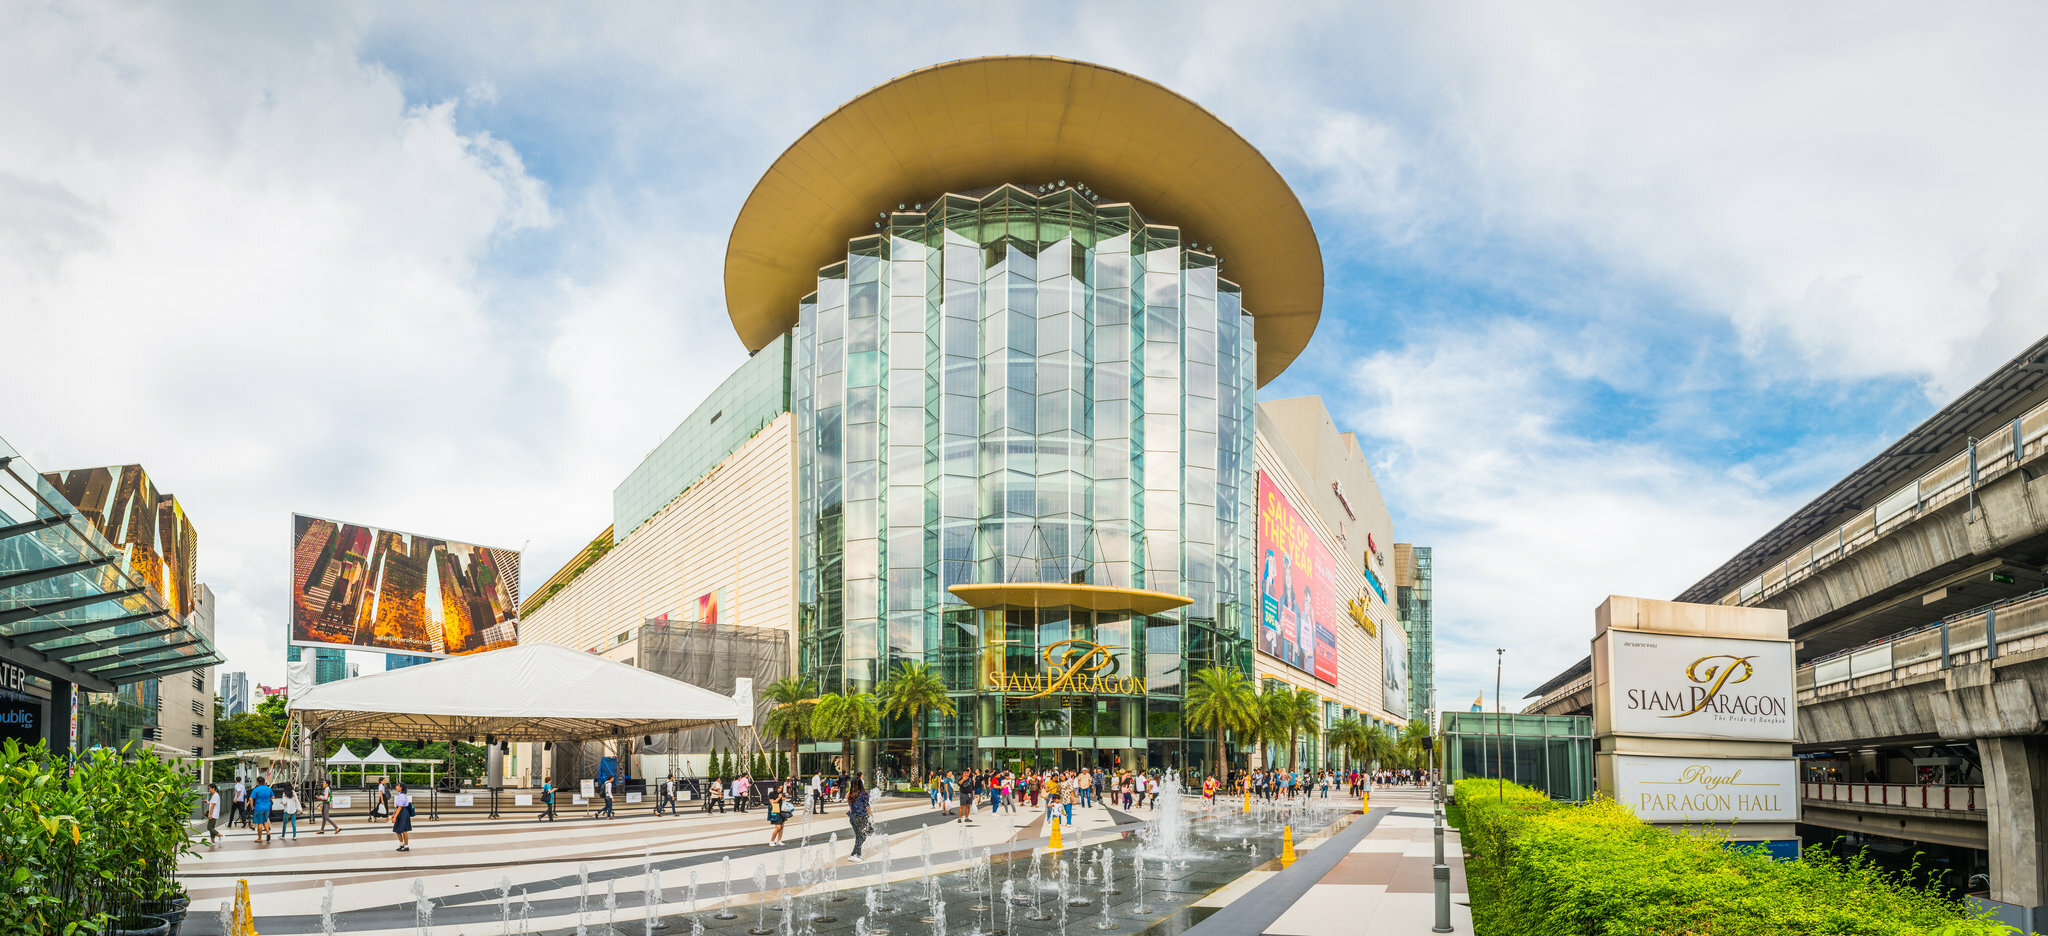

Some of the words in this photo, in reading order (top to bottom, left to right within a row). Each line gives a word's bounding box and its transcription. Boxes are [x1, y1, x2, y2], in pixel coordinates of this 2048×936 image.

[1268, 491, 1296, 539] SALE
[1297, 527, 1309, 553] OF
[1262, 509, 1286, 553] THE
[1288, 535, 1313, 580] YEAR
[989, 671, 1042, 692] SIAM
[1047, 666, 1147, 696] PARAGON
[1627, 688, 1684, 712] SIAM
[1690, 686, 1786, 715] PARAGON
[0, 709, 33, 724] ublic
[1749, 716, 1757, 724] of
[1759, 716, 1786, 724] Bangkok
[1682, 765, 1742, 790] Royal
[1641, 793, 1731, 812] PARAGON
[1738, 794, 1782, 812] HALL
